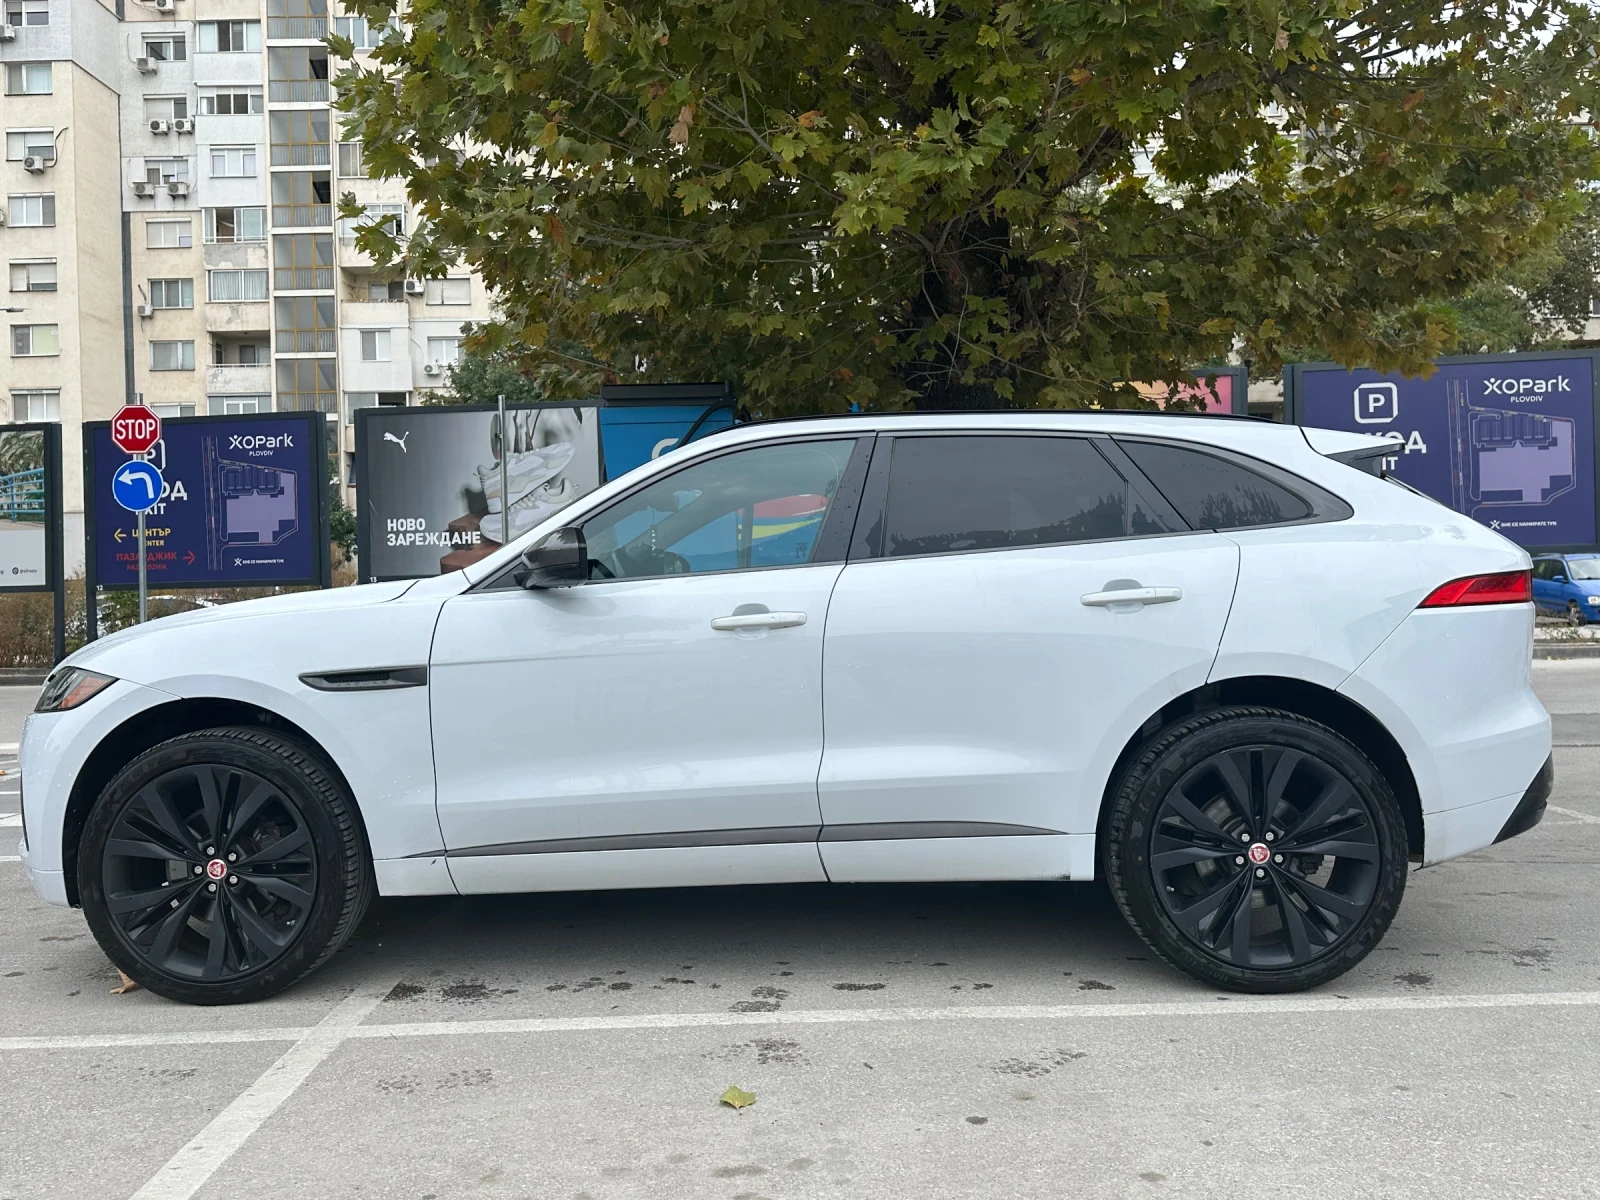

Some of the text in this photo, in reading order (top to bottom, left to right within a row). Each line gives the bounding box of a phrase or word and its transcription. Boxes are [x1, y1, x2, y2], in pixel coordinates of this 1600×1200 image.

[1483, 375, 1571, 395] XOPark
[1368, 393, 1386, 413] P
[1510, 395, 1544, 403] PLOVDIV
[115, 418, 156, 440] STOP
[228, 432, 294, 450] XOPark
[132, 527, 171, 538] ЦНТЪР
[386, 518, 426, 532] НОВО
[386, 531, 482, 547] ЗАРЕЖДАНЕ
[116, 552, 177, 561] ПАЗДЖИК
